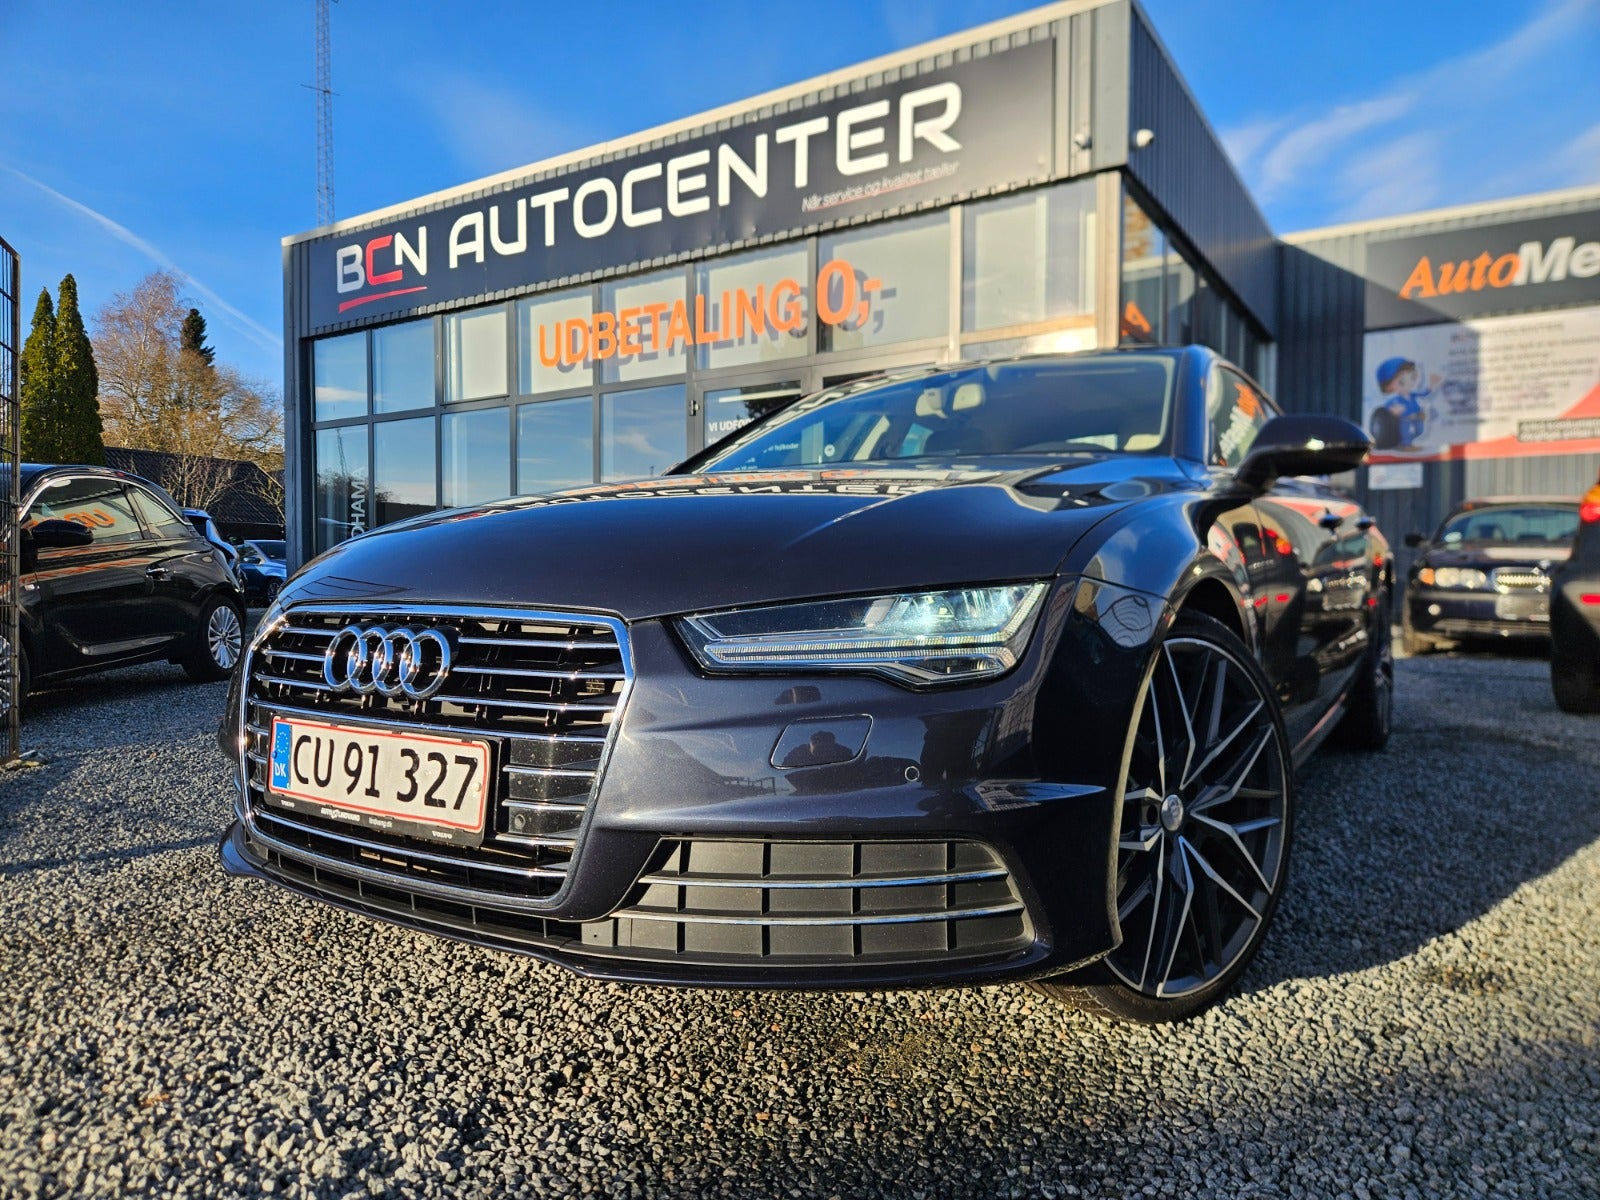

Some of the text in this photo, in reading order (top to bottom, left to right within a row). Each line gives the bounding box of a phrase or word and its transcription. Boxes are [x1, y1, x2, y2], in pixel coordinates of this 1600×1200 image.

[337, 81, 963, 294] BCN AUTOCENTER
[539, 277, 802, 367] UDBETALING
[707, 421, 718, 432] VI
[274, 762, 287, 778] DK
[294, 734, 479, 811] CU 91 327
[432, 830, 453, 840] VOLVO
